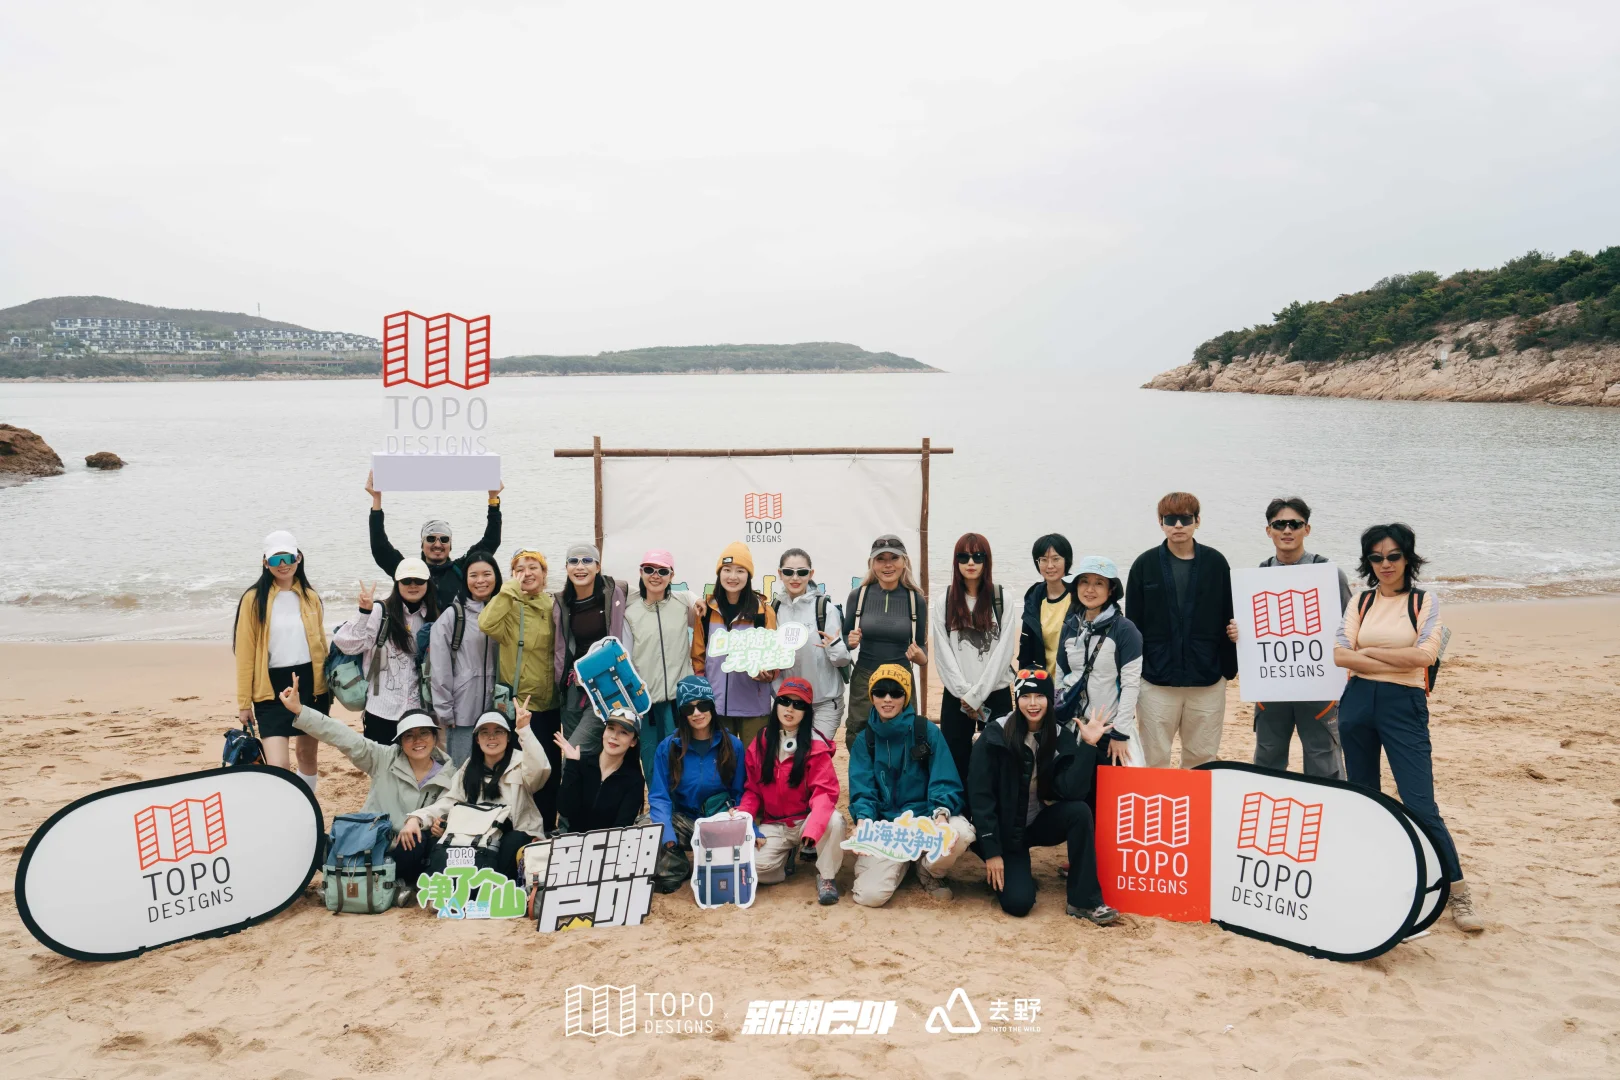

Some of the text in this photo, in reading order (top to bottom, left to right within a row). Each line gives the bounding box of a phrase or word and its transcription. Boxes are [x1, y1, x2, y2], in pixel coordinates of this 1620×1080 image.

[385, 395, 488, 431] TOPO
[386, 435, 487, 455] DESIGNS
[745, 521, 782, 534] TOPO
[745, 534, 782, 543] DESIGNS
[1257, 639, 1323, 663] TOPO
[1259, 664, 1325, 679] DESIGNS
[447, 848, 474, 859] TOPO
[545, 825, 663, 887] 新潮
[1117, 848, 1189, 878] TOPO
[142, 856, 231, 901] TOPO
[1117, 875, 1188, 895] DESIGNS
[1236, 854, 1312, 899] TOPO
[147, 886, 234, 923] DESIGNS
[1232, 886, 1309, 921] DESIGNS
